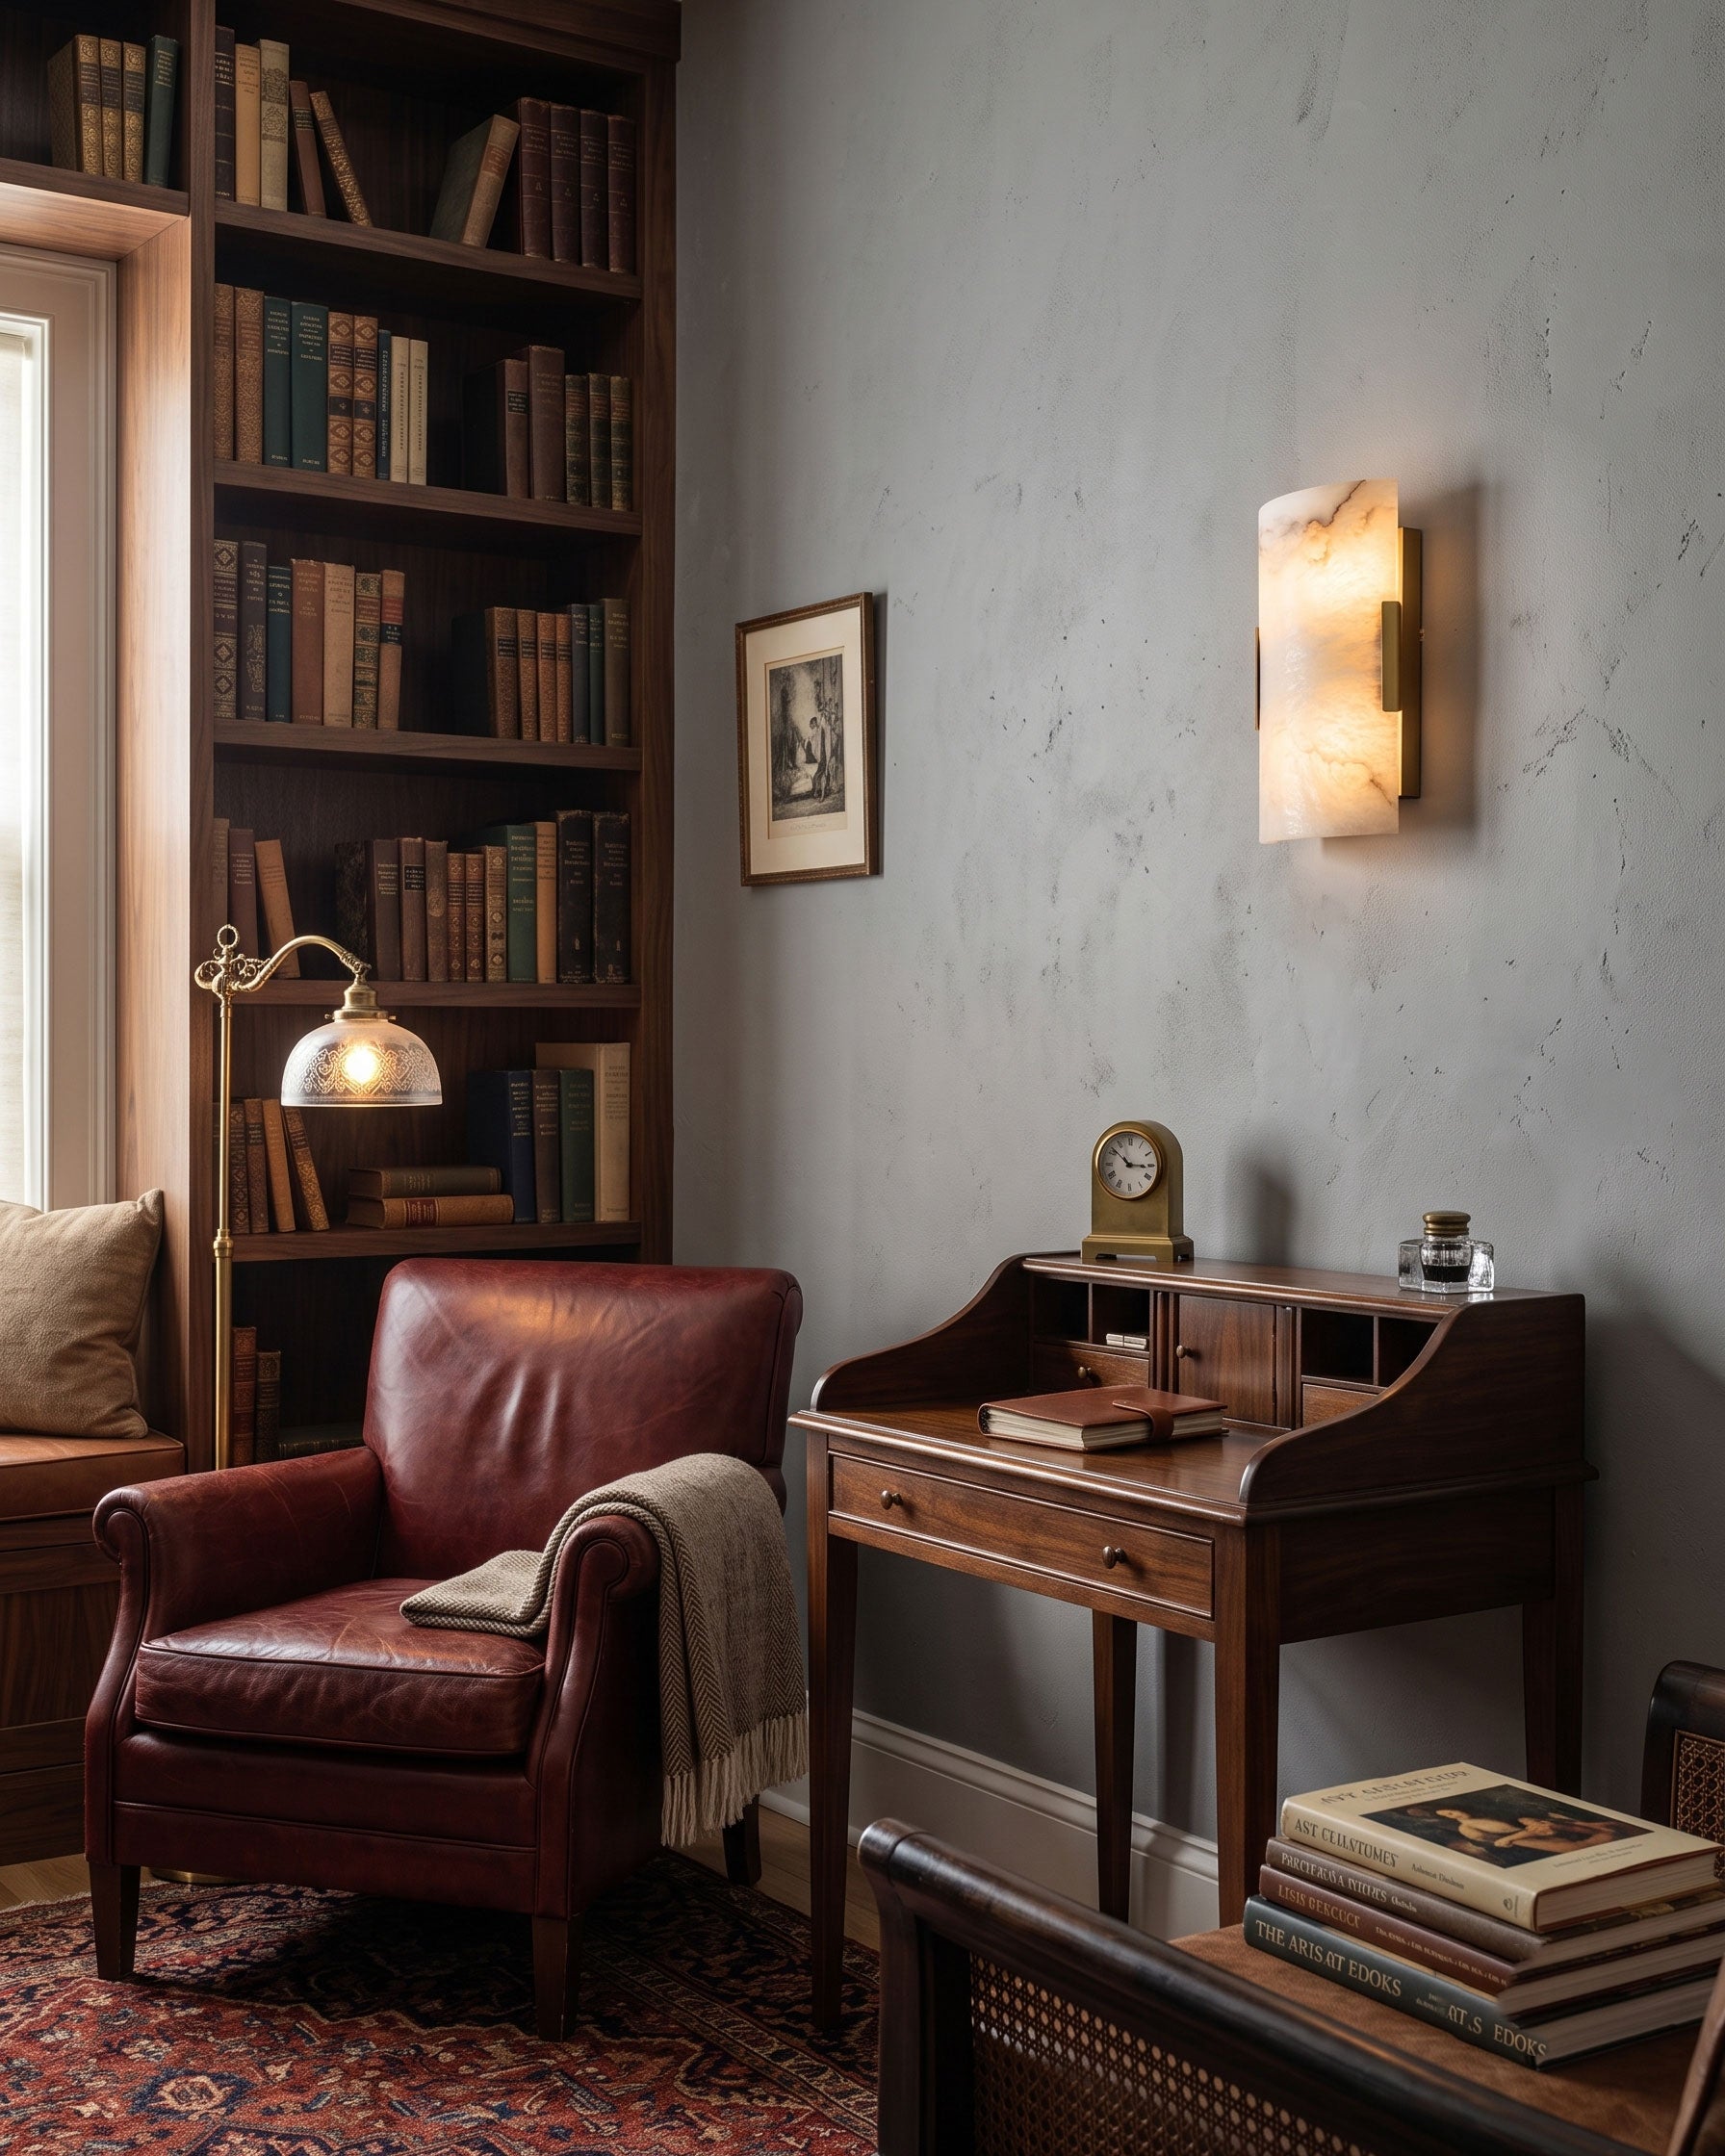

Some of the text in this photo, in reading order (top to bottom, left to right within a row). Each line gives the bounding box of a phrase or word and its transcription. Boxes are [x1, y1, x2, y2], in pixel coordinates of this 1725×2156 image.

[1295, 1818, 1319, 1837] AST
[1256, 1919, 1285, 1946] THE
[1349, 1959, 1402, 1997] EDOKS
